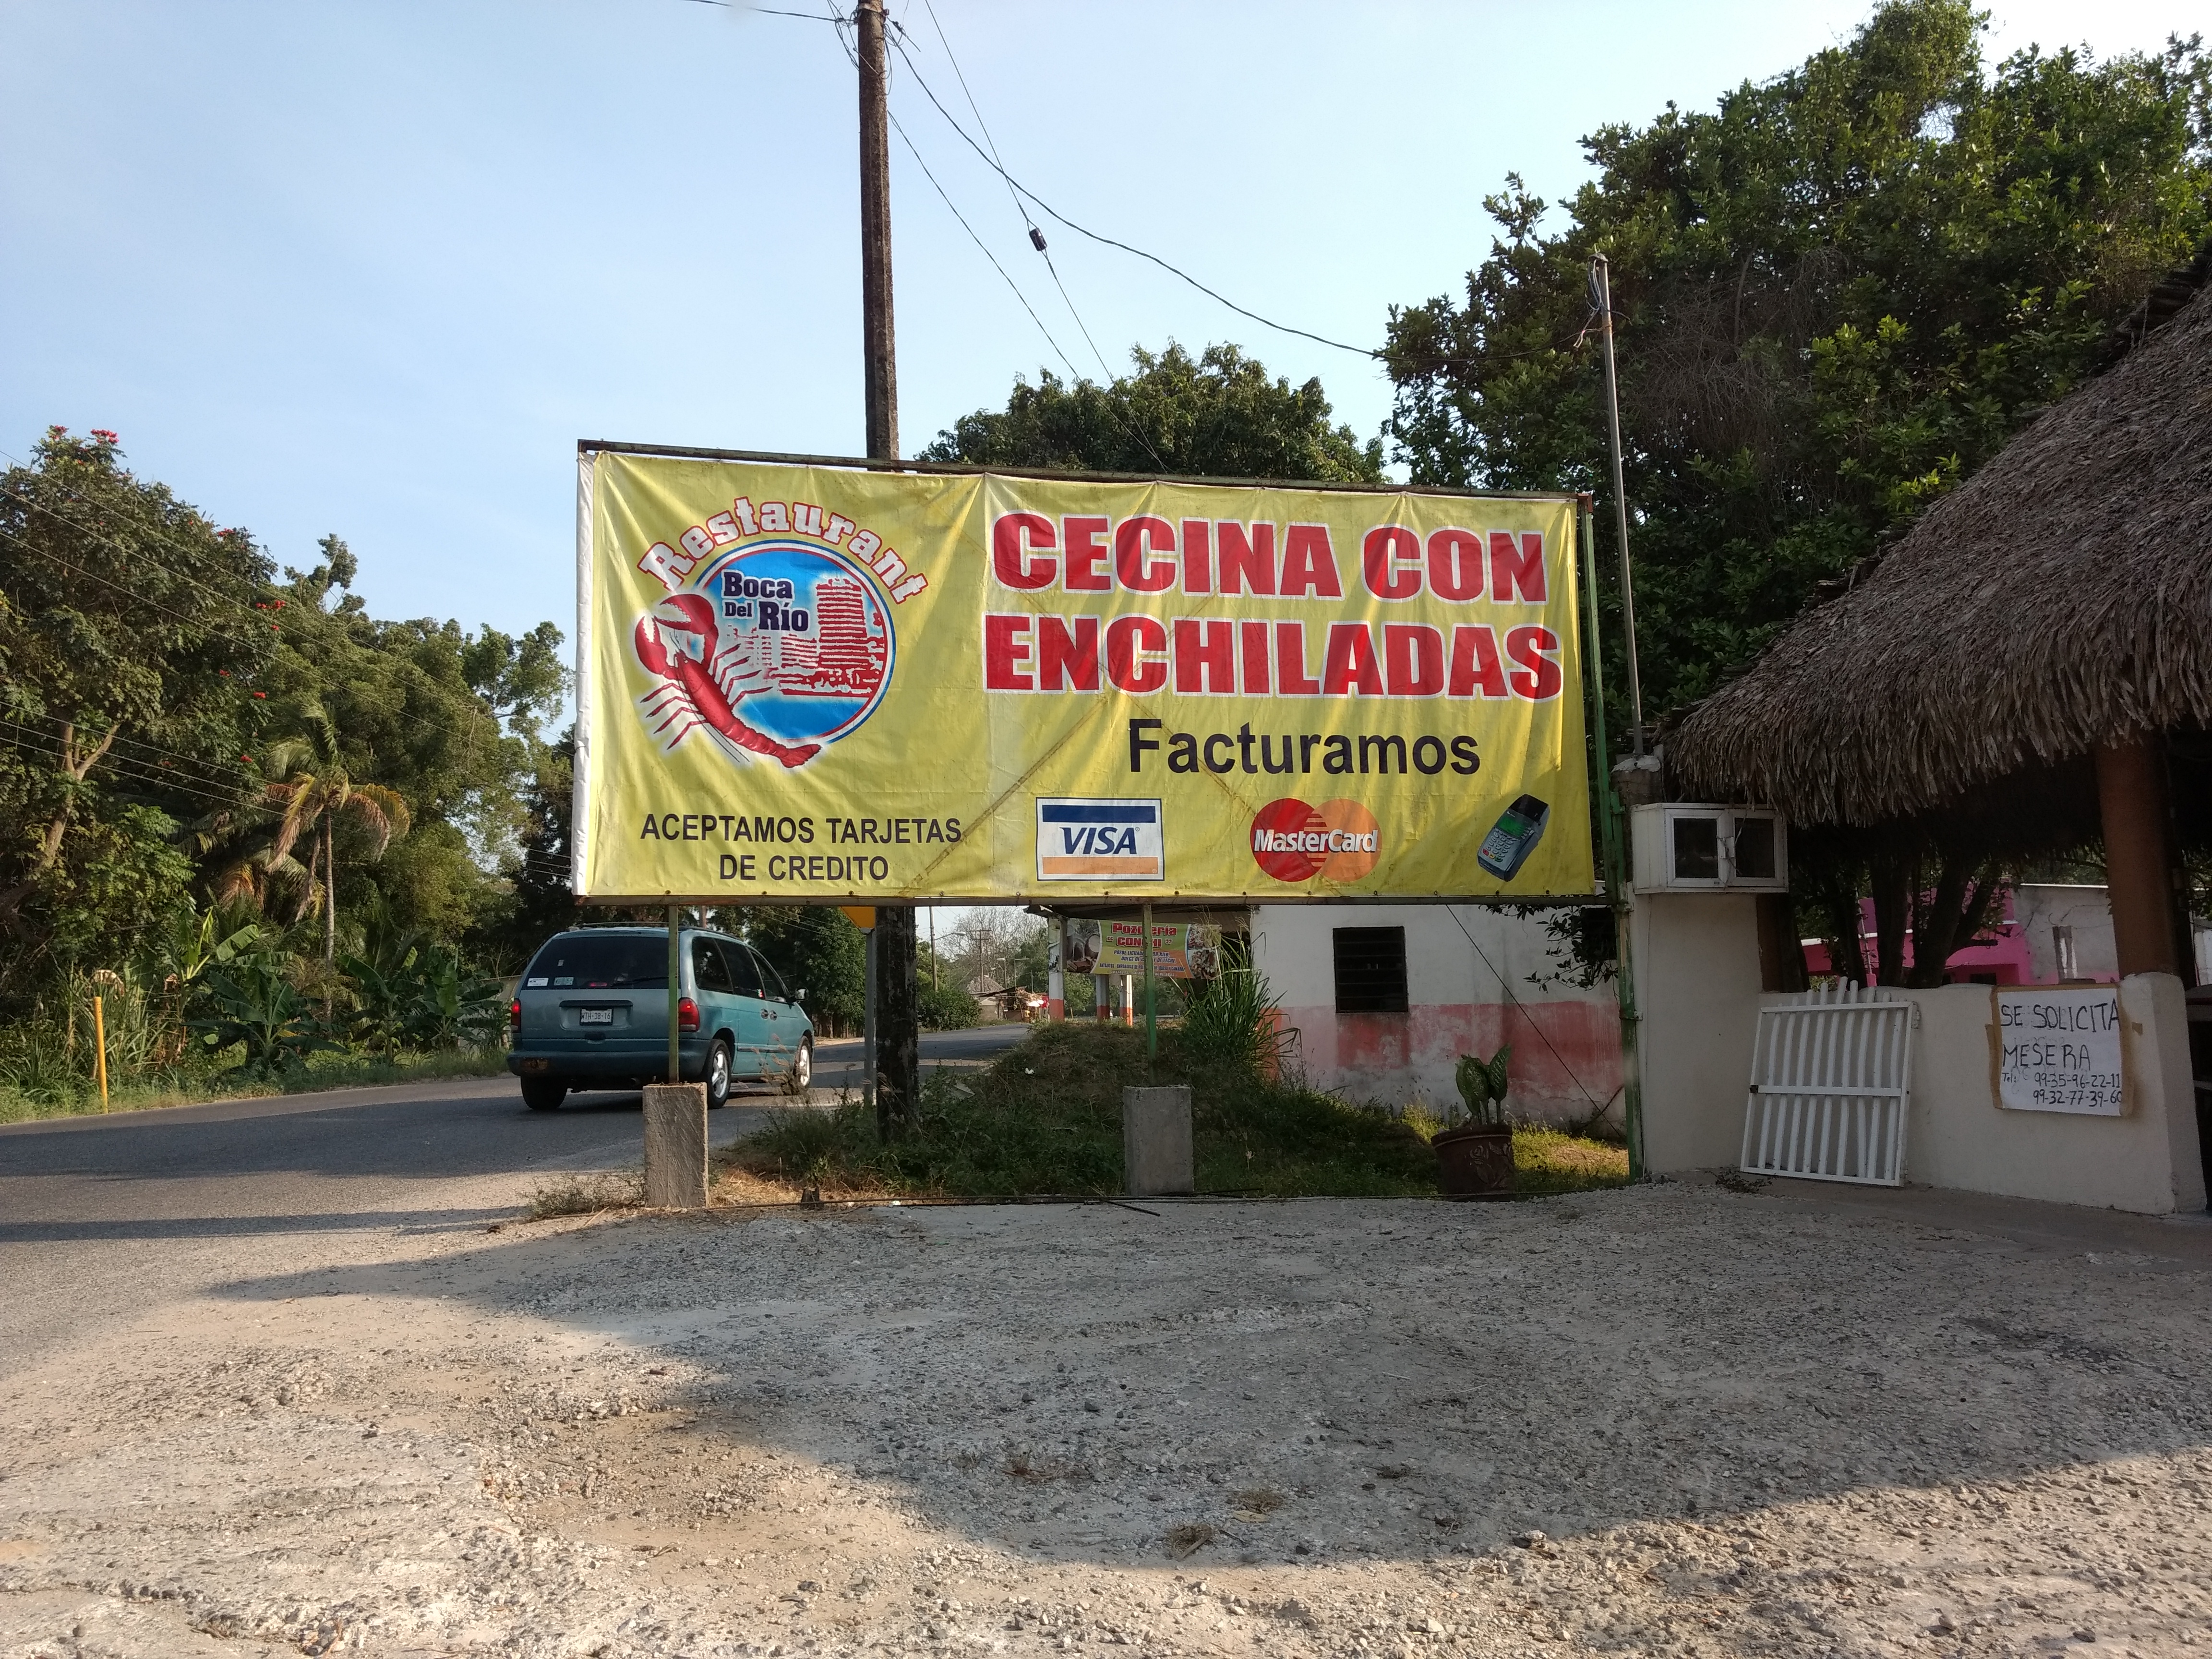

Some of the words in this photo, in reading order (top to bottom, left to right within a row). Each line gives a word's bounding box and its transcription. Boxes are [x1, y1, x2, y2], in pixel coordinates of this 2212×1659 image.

[637, 496, 929, 605] Restaurant
[992, 510, 1345, 601] CECINA
[1362, 523, 1550, 605] CON
[722, 572, 793, 600] Boca
[725, 602, 753, 618] Del
[758, 603, 809, 632] Río
[983, 611, 1563, 703] ENCHILADAS
[1130, 718, 1480, 774] Facturamos
[640, 814, 815, 843] ACEPTAMOS
[826, 818, 962, 843] TARJETAS
[1059, 827, 1137, 854] VISA
[1254, 829, 1379, 853] MasterCard
[720, 855, 756, 880] DE
[769, 855, 889, 881] CREDITO
[1112, 922, 1177, 936] Pozoería
[2001, 1004, 2022, 1026] SE
[2033, 998, 2119, 1033] SOLICITA
[2002, 1044, 2091, 1070] MESERA
[2034, 1072, 2120, 1089] 99-35-96-22-11
